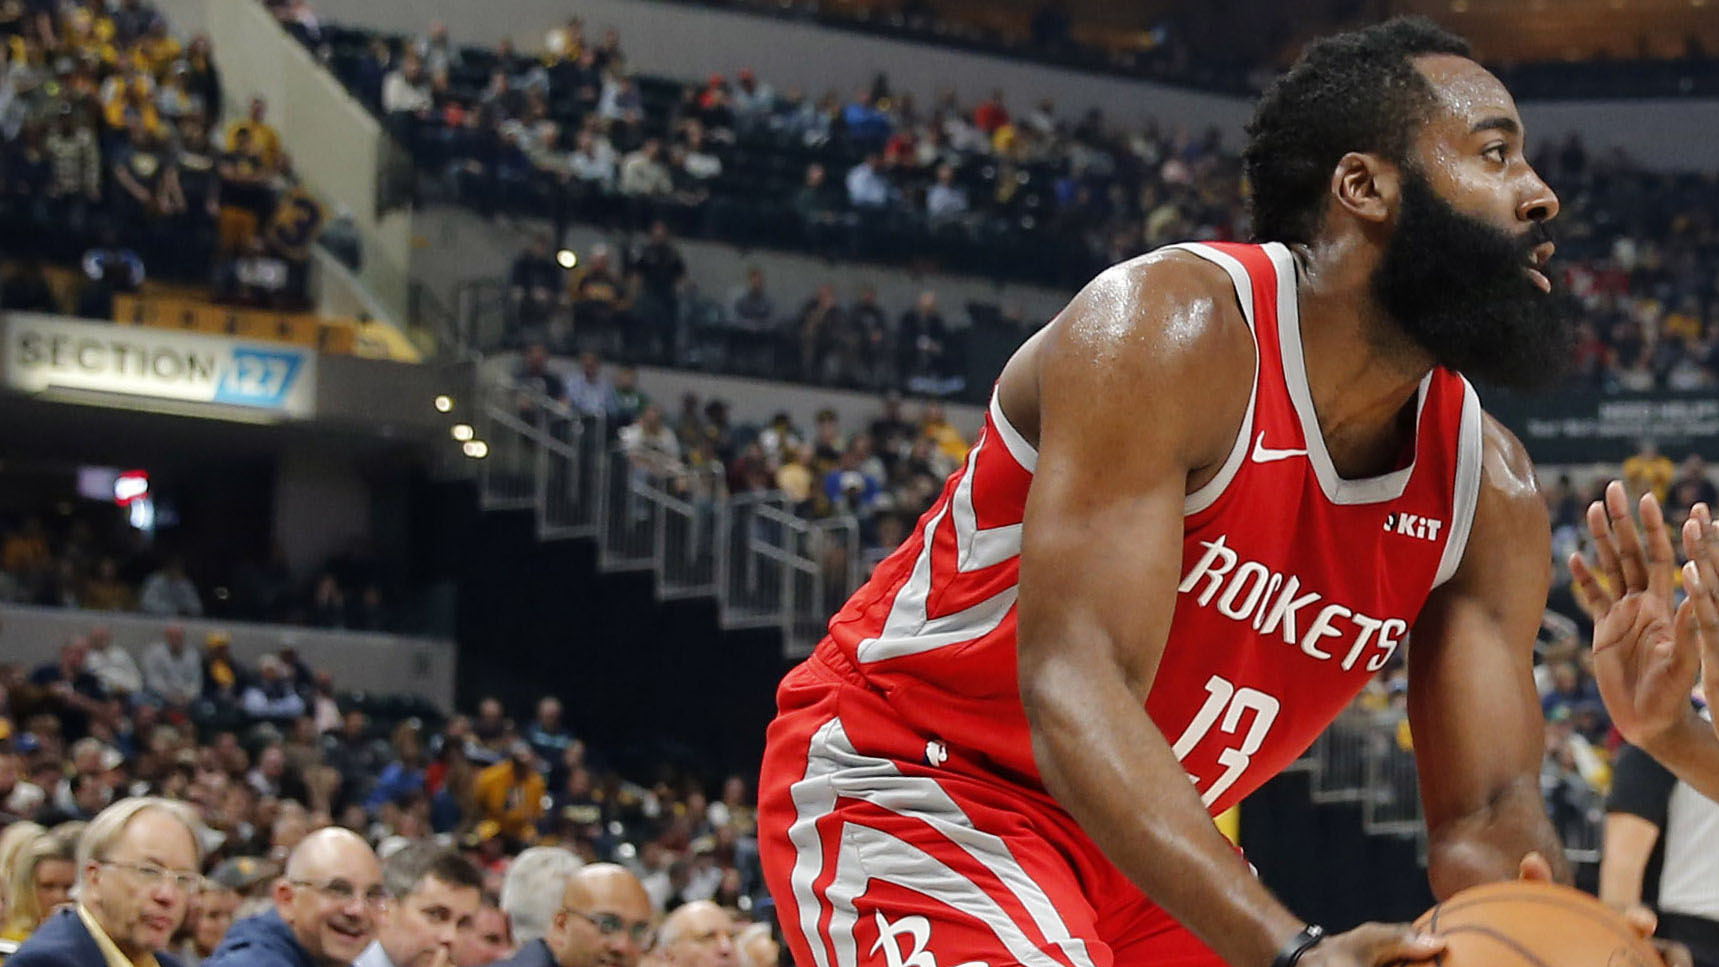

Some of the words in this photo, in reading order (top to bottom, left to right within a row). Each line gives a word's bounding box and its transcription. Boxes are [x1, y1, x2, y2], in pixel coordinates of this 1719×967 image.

[16, 332, 215, 384] SECTION
[226, 353, 291, 397] 127
[1178, 534, 1407, 672] ROCKETS
[1171, 674, 1280, 809] 13
